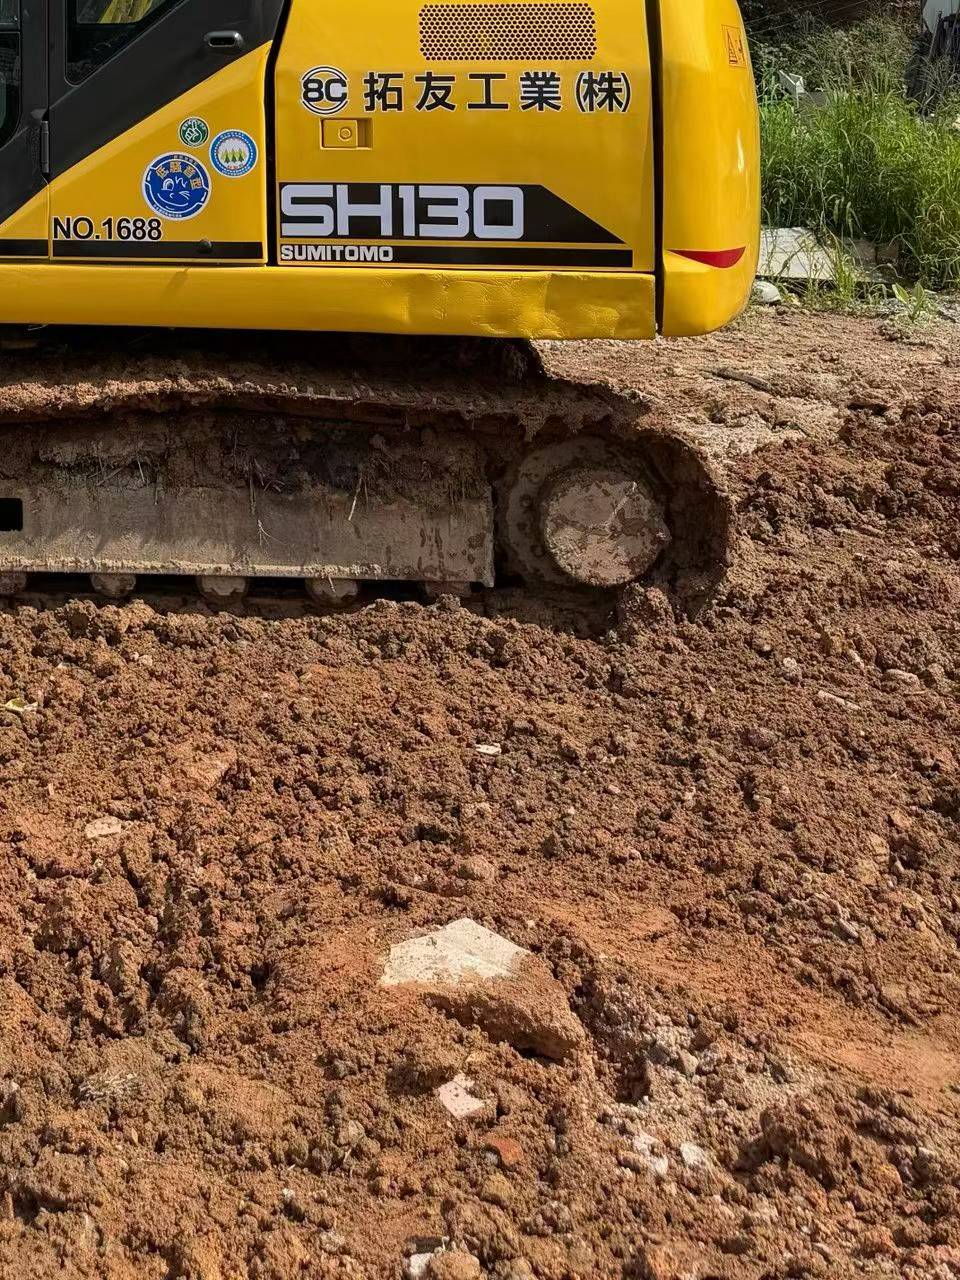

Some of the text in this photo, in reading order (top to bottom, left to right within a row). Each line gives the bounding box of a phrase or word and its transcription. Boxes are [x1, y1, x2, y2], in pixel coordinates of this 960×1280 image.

[281, 184, 524, 240] SH130
[53, 217, 162, 240] NO.1688
[280, 245, 393, 261] SUMITOMO
